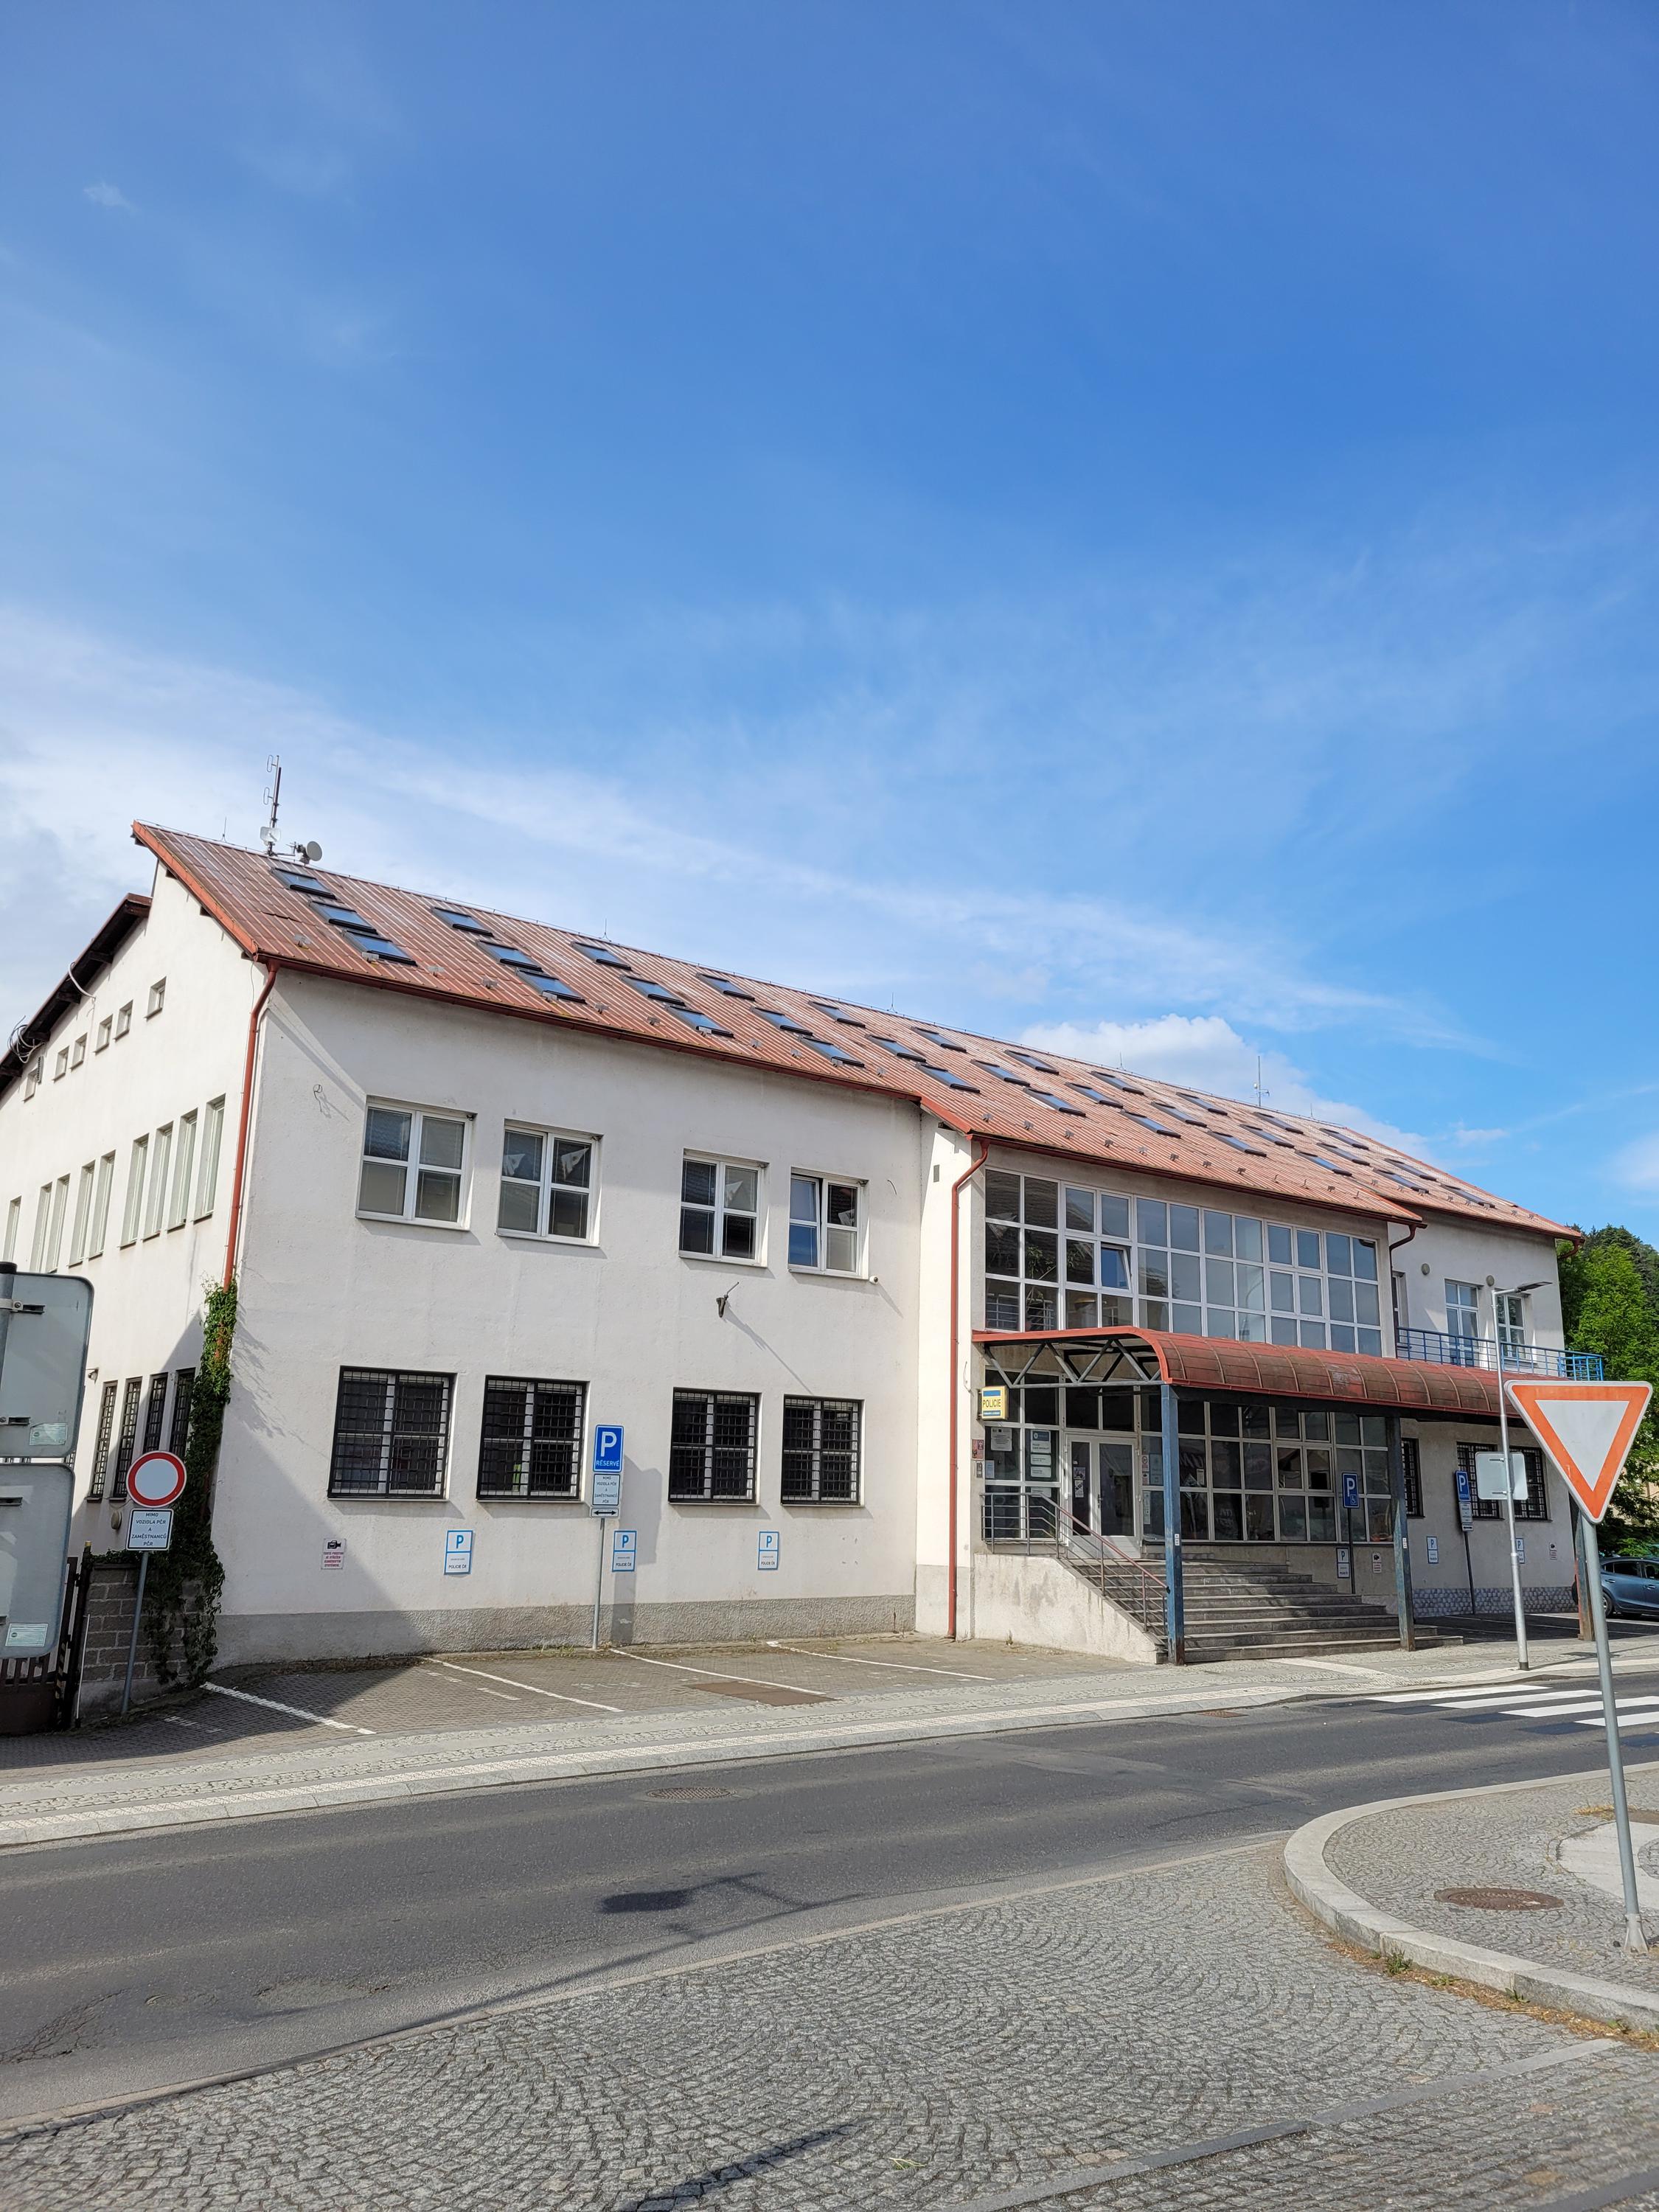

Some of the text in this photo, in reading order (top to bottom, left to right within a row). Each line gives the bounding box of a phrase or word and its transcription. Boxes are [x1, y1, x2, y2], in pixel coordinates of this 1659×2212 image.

[983, 1399, 1001, 1408] POLICIE
[600, 1431, 617, 1457] P
[596, 1459, 619, 1467] RÉSERVÉ
[1346, 1478, 1355, 1498] P
[1459, 1475, 1466, 1492] P
[456, 1534, 464, 1549] P
[622, 1534, 629, 1548] P
[766, 1535, 773, 1548] P
[1341, 1551, 1346, 1561] P
